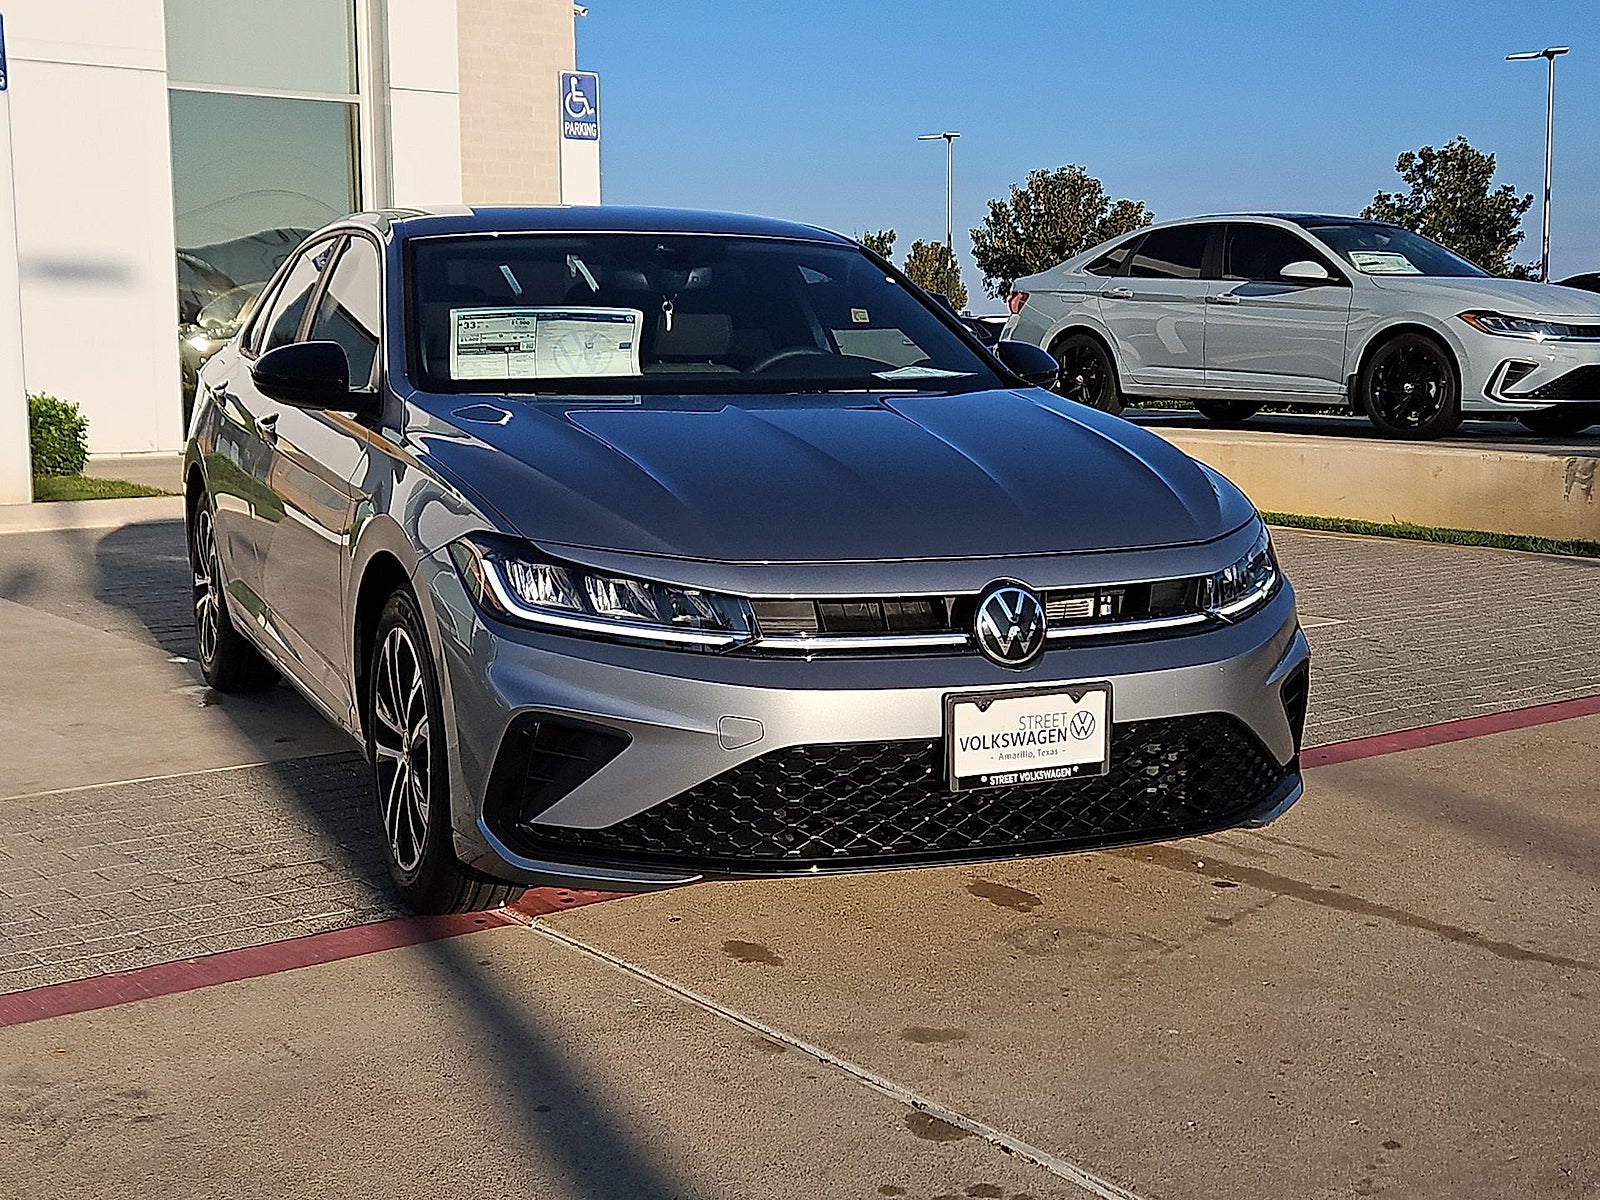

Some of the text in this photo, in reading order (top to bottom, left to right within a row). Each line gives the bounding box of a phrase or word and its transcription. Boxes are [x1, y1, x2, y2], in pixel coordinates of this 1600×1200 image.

[564, 121, 597, 137] PARKING
[463, 321, 476, 329] 33
[1018, 712, 1068, 731] STREET
[959, 727, 1068, 752] VOLKSWAGEN
[998, 748, 1059, 761] Amarillo, Texas
[989, 767, 1072, 786] STREET VOLKSWAGEN
